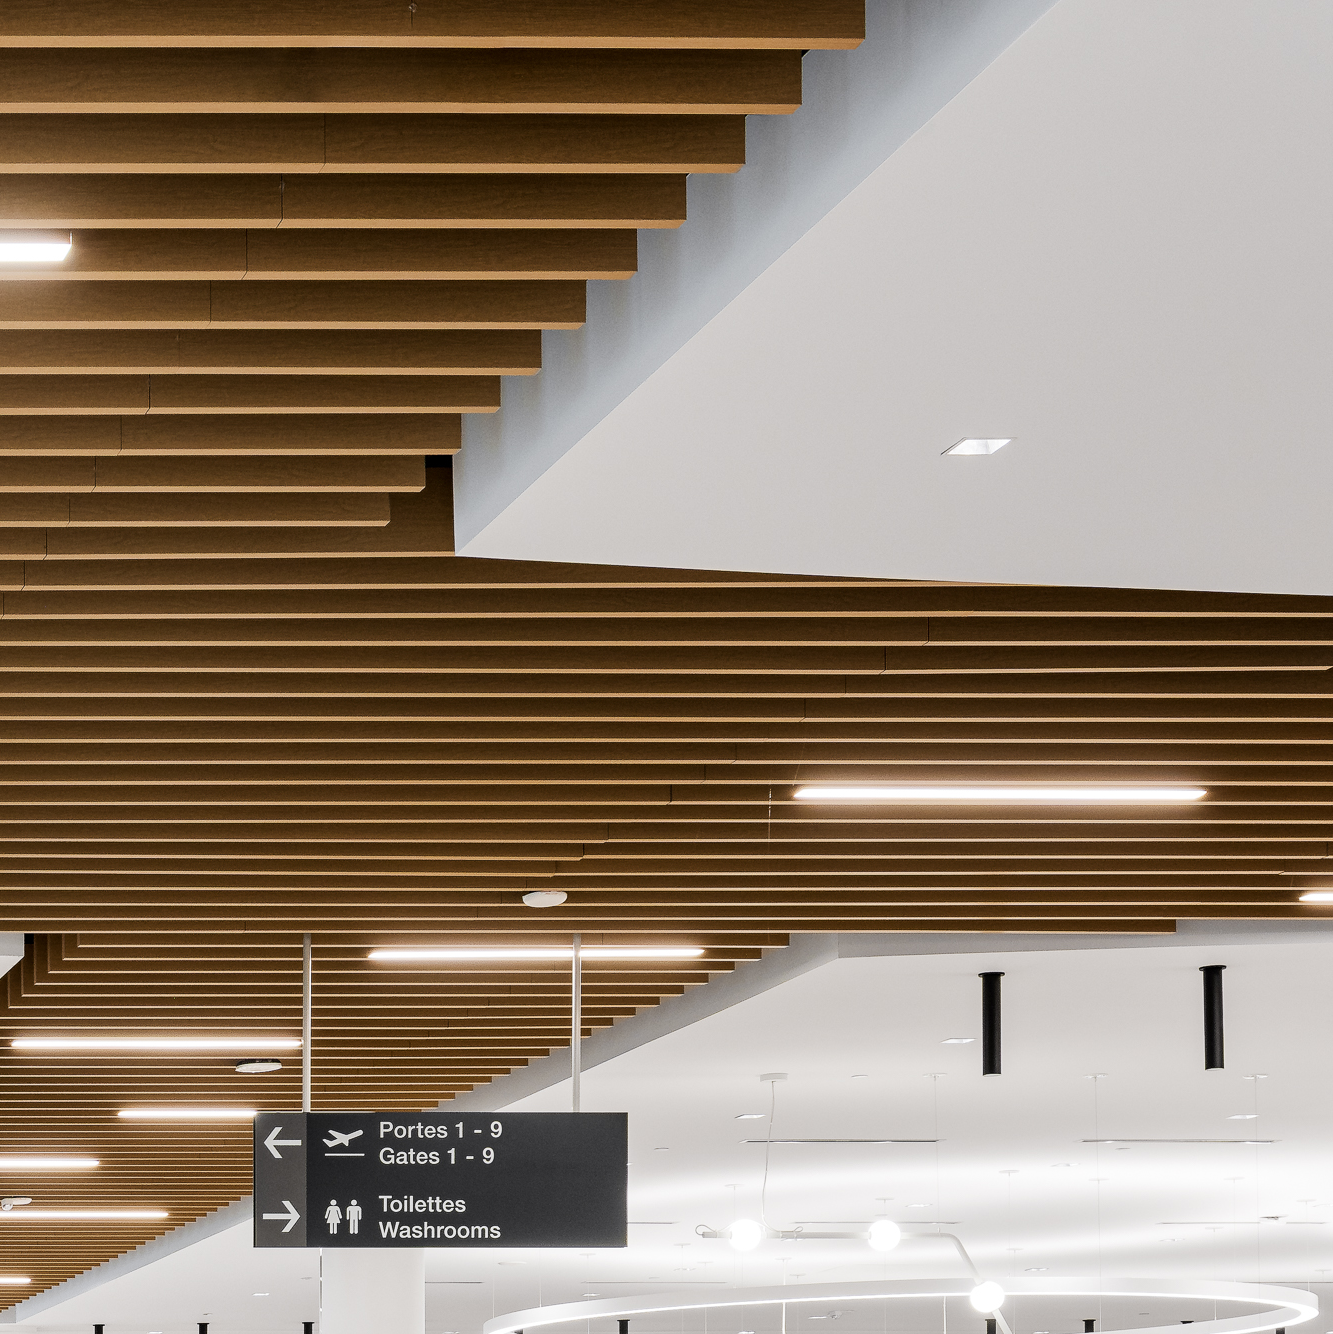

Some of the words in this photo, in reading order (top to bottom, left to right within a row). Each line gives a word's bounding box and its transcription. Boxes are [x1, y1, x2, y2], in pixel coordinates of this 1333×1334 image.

[379, 1121, 448, 1139] Portes
[455, 1121, 464, 1139] 1
[490, 1120, 503, 1139] 9
[379, 1146, 440, 1165] Gates
[447, 1147, 456, 1165] 1
[482, 1146, 495, 1165] 9
[378, 1195, 467, 1213] Toilettes
[378, 1221, 502, 1239] Washrooms
